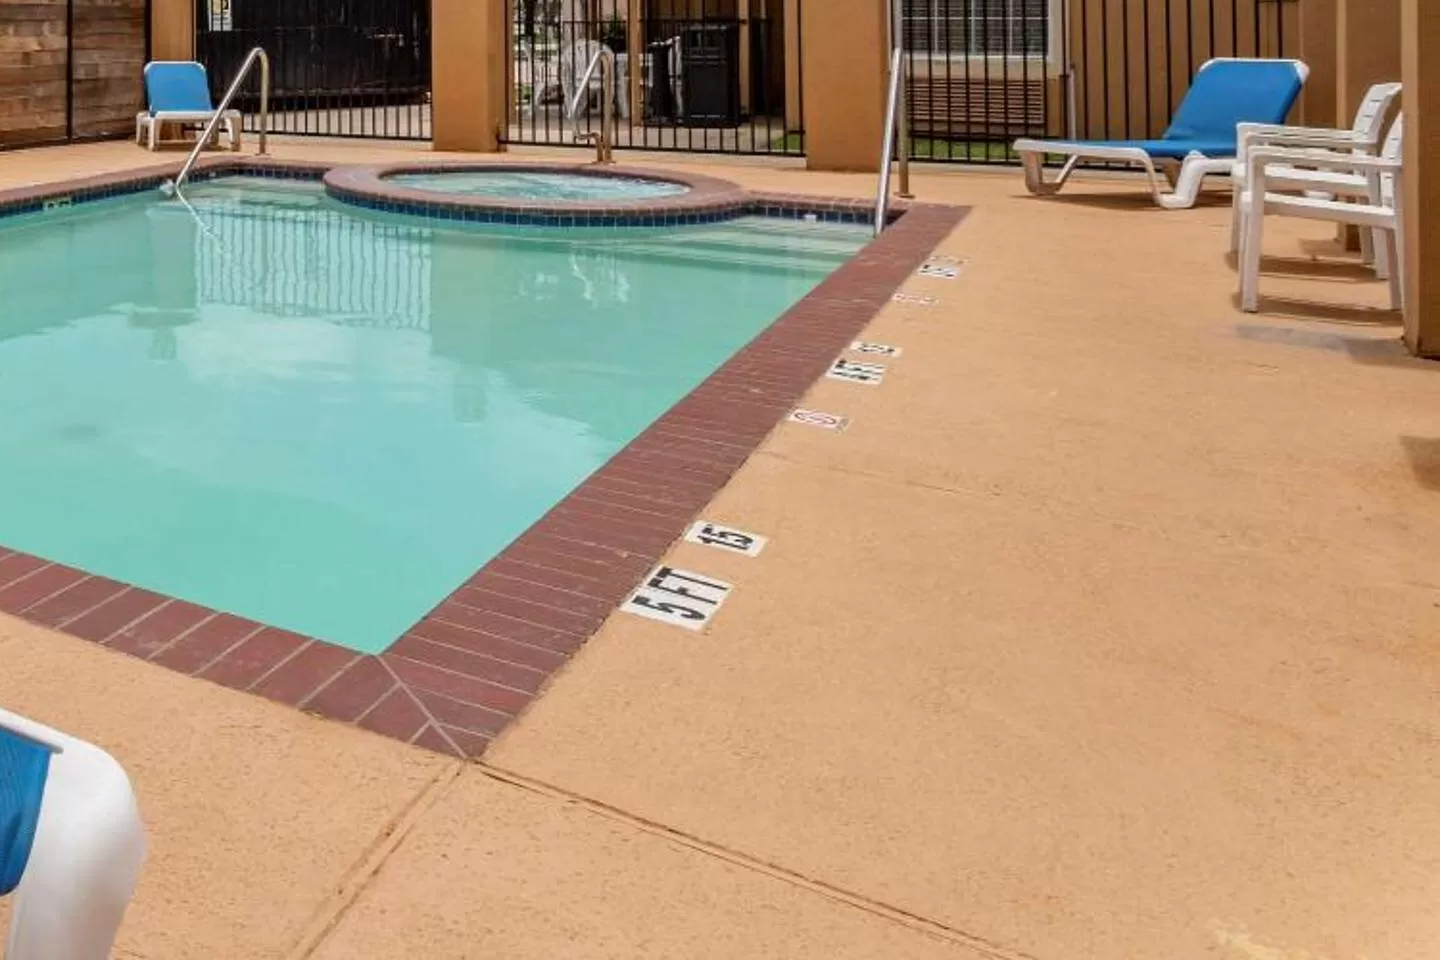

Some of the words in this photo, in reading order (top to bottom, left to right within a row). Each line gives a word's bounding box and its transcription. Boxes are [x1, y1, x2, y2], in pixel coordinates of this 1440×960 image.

[696, 523, 755, 551] 15
[646, 566, 729, 606] FT
[630, 595, 707, 622] 5
